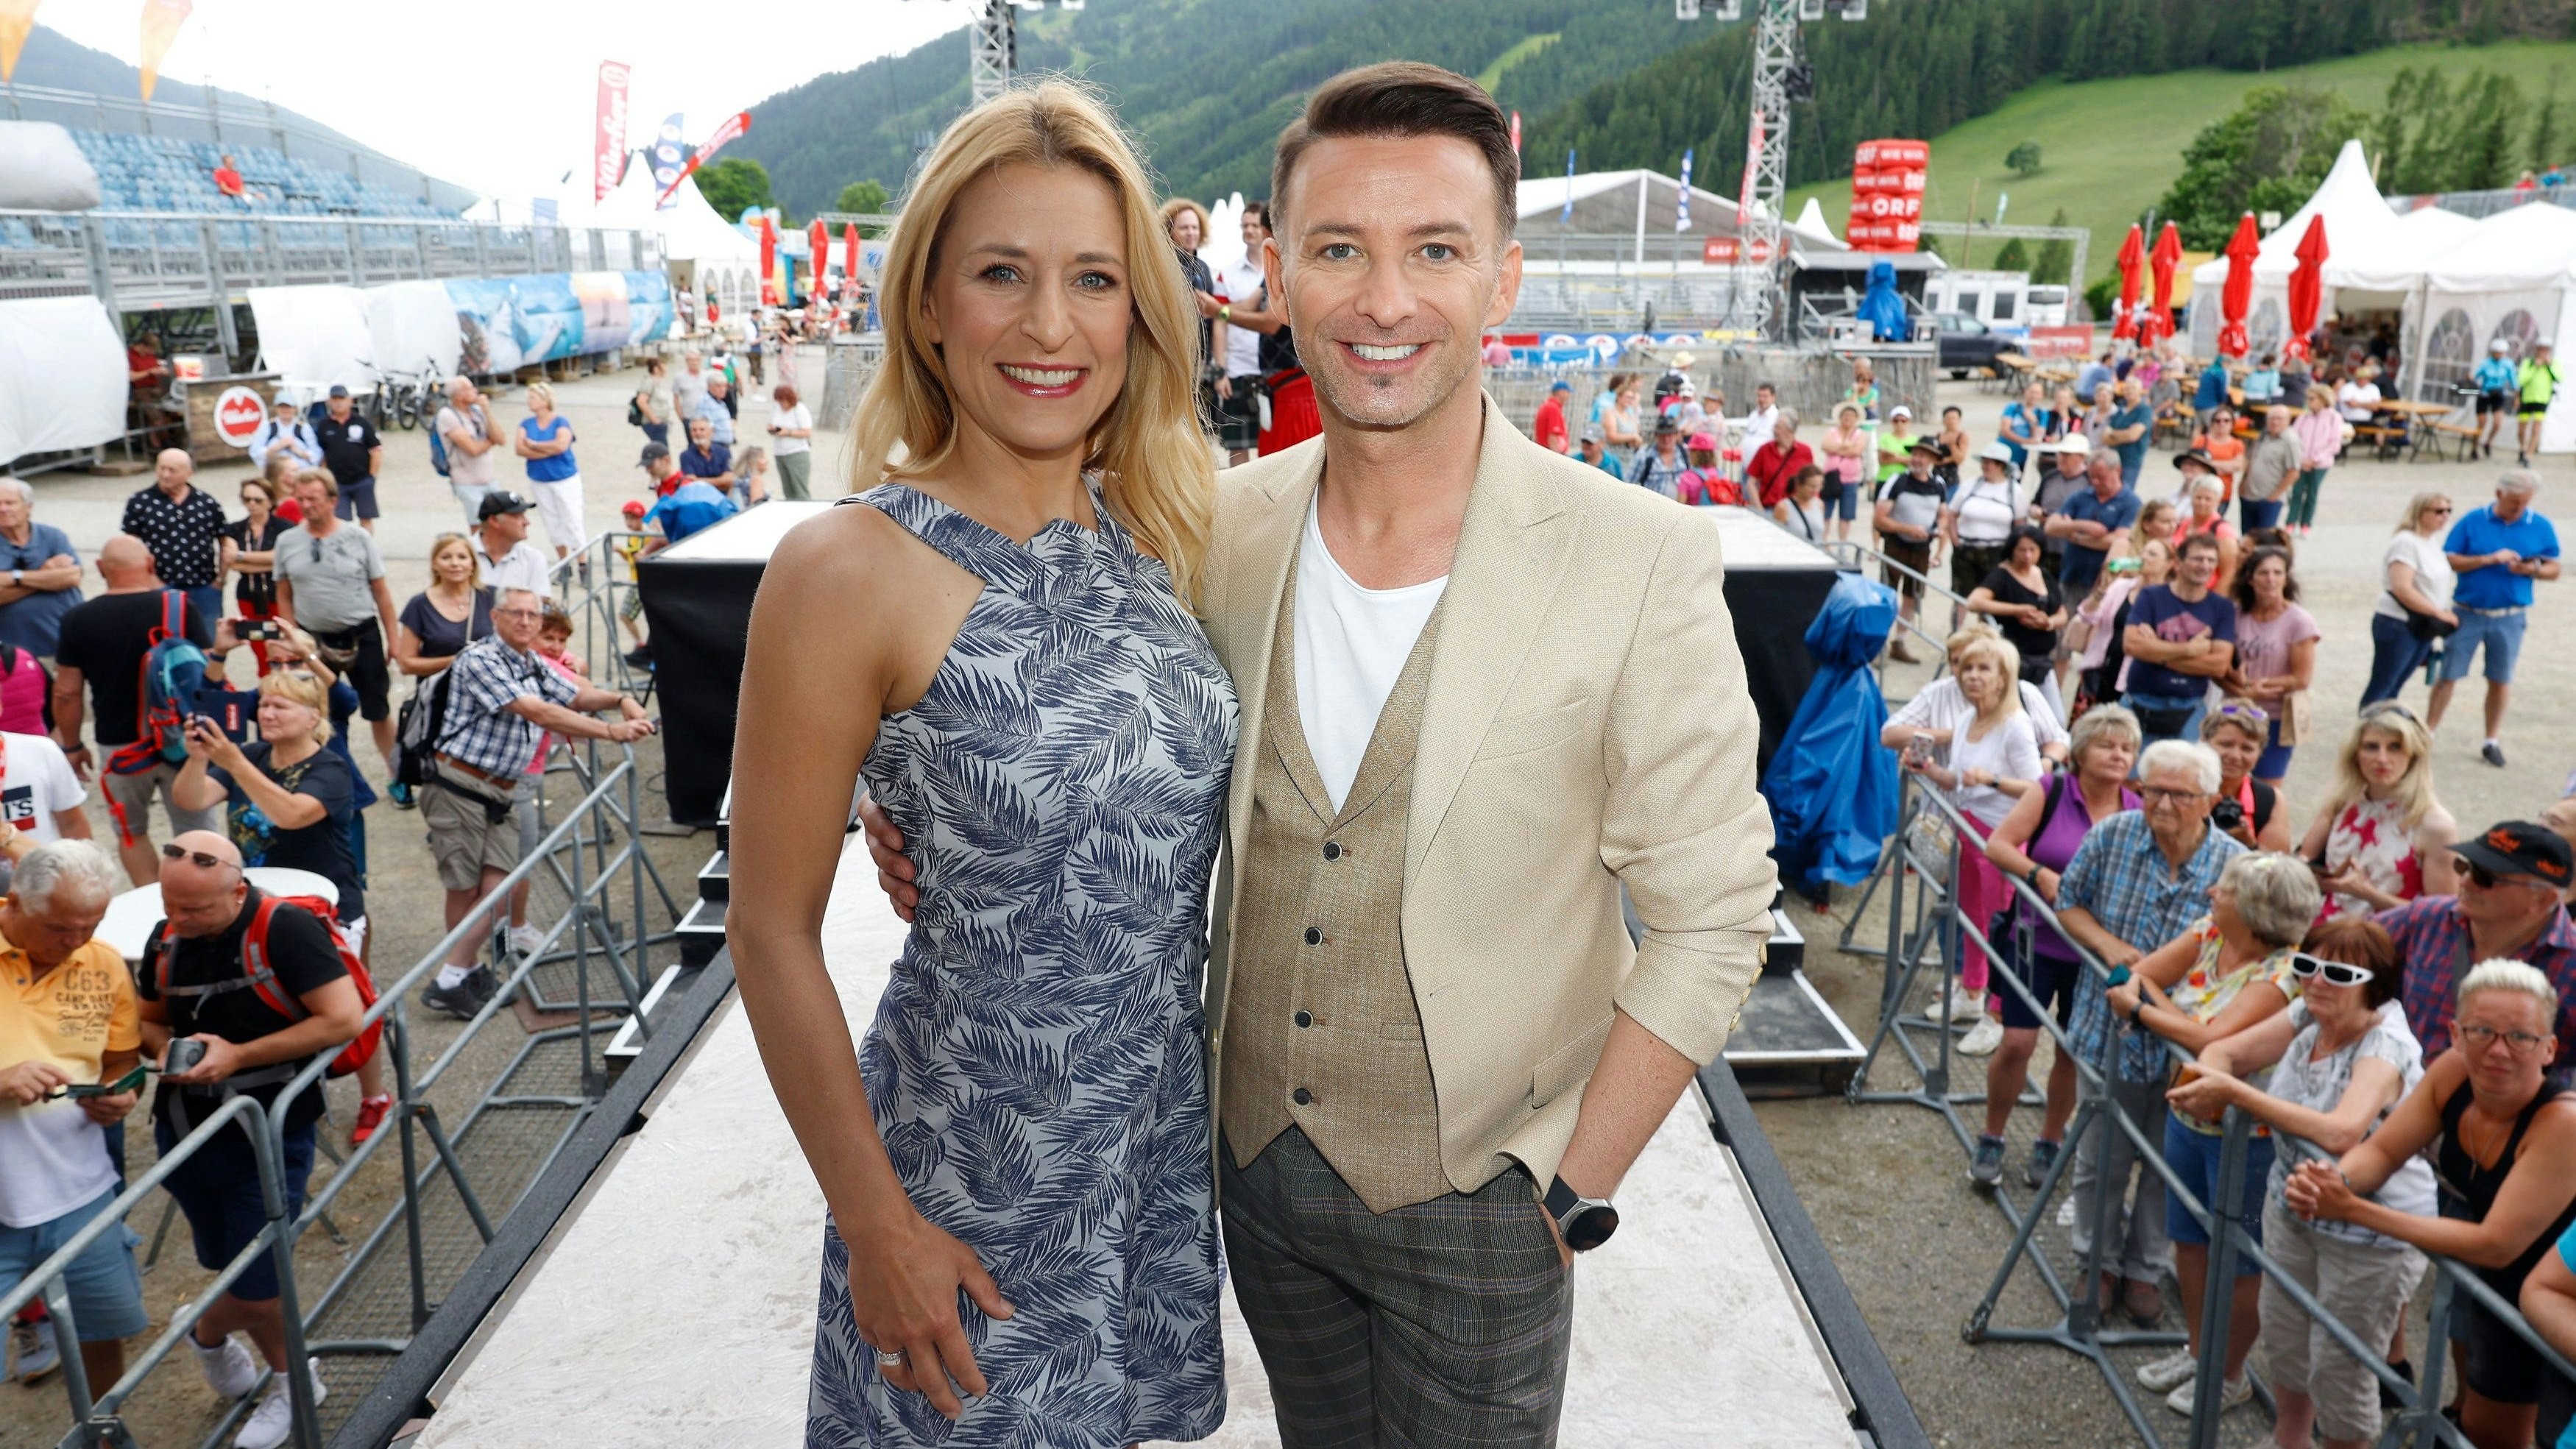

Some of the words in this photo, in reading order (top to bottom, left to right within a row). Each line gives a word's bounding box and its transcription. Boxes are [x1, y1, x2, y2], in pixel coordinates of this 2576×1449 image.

[1872, 198, 1920, 216] ORF
[65, 968, 111, 991] C63
[55, 992, 85, 1004] CAMP
